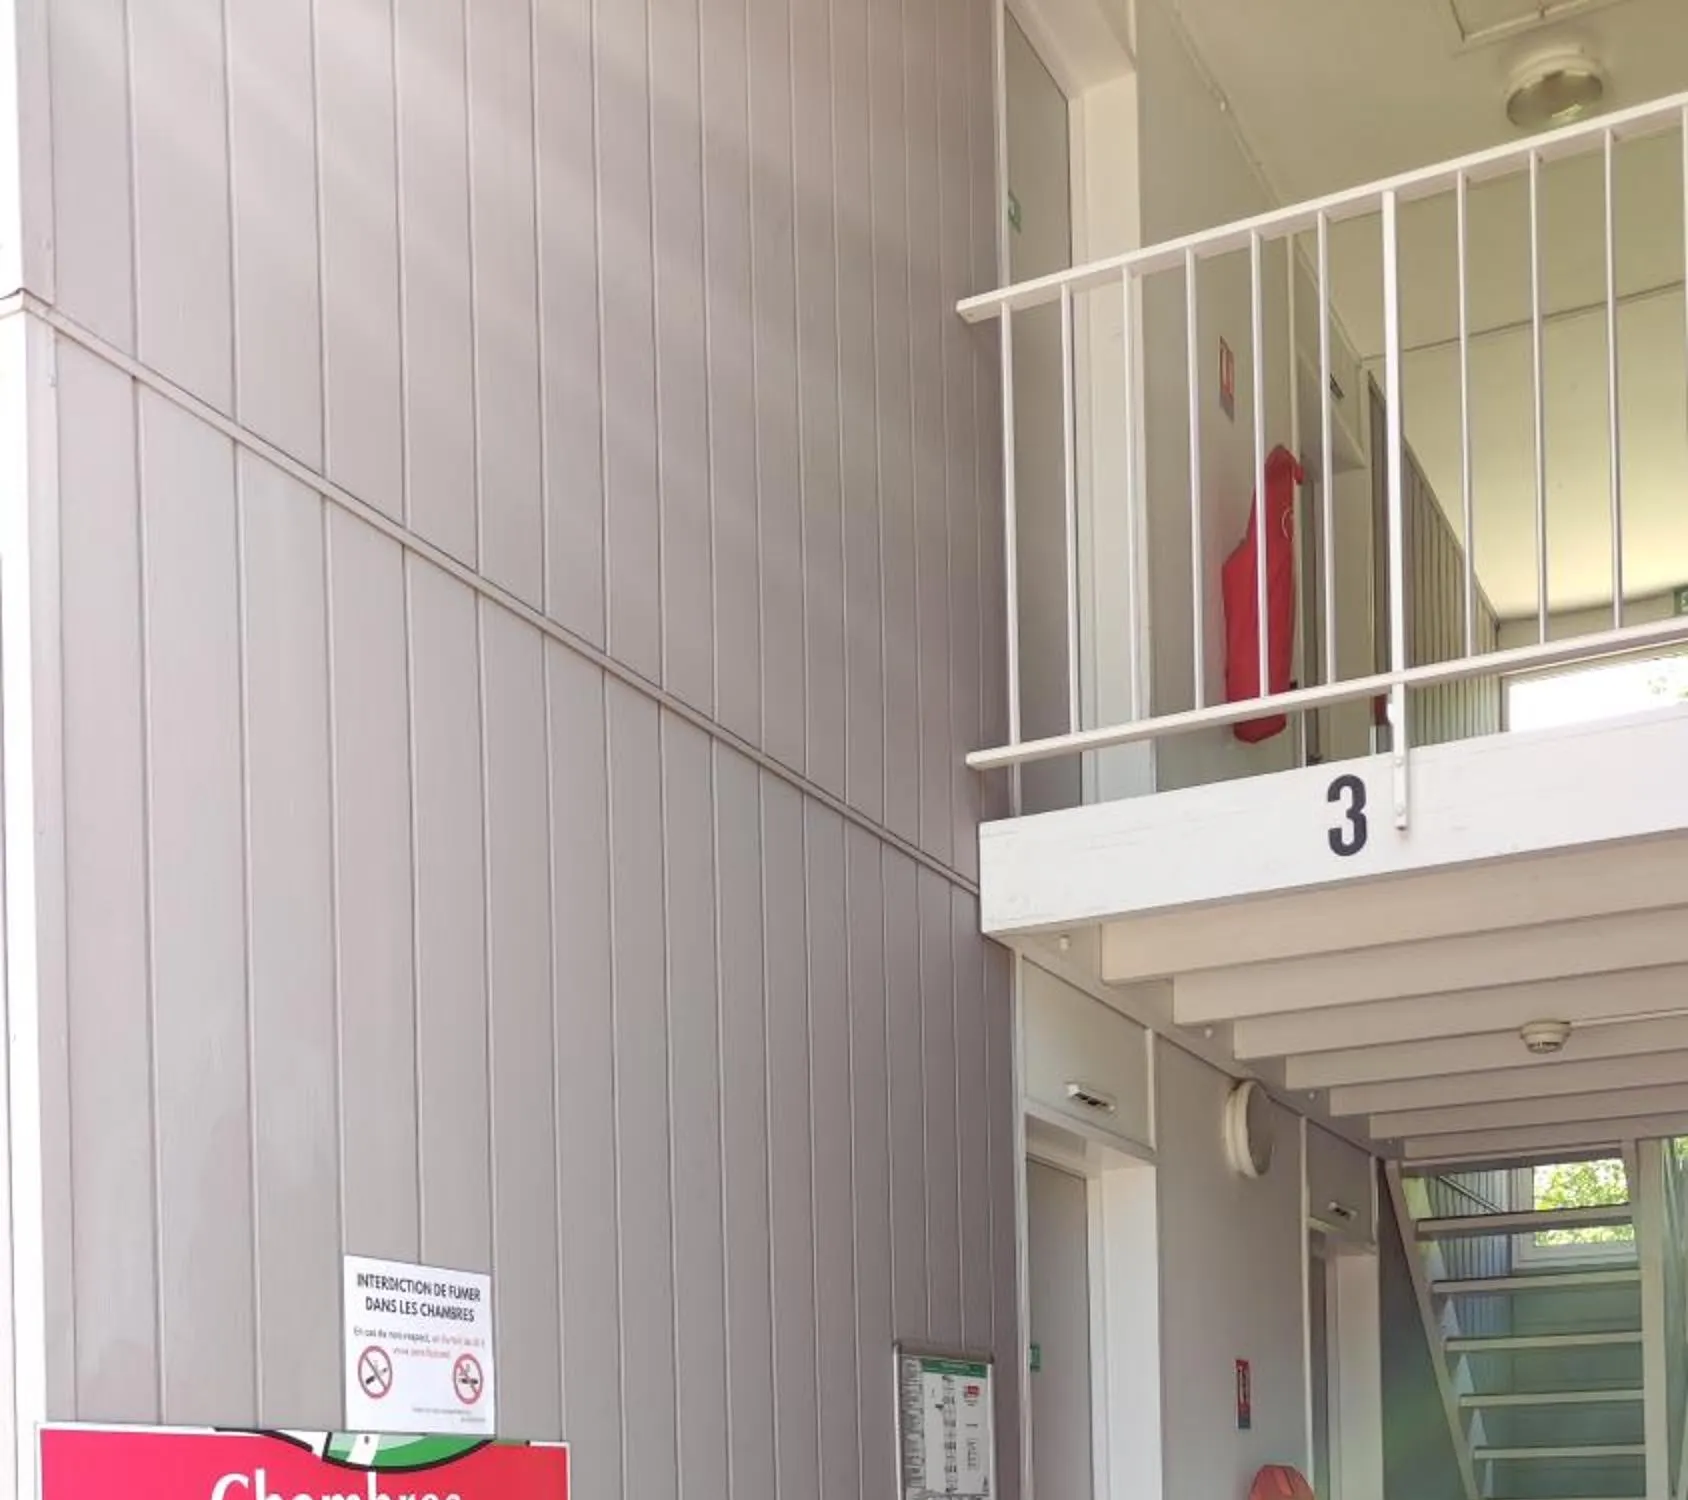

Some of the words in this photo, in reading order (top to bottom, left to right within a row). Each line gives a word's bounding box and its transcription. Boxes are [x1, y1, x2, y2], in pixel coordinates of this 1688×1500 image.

[1327, 773, 1367, 857] 3
[356, 1273, 432, 1296] INTERDICTION
[433, 1283, 447, 1298] DE
[449, 1286, 481, 1302] FUMER
[365, 1296, 397, 1313] DANS
[399, 1300, 418, 1315] LES
[420, 1303, 475, 1322] CHAMBRES
